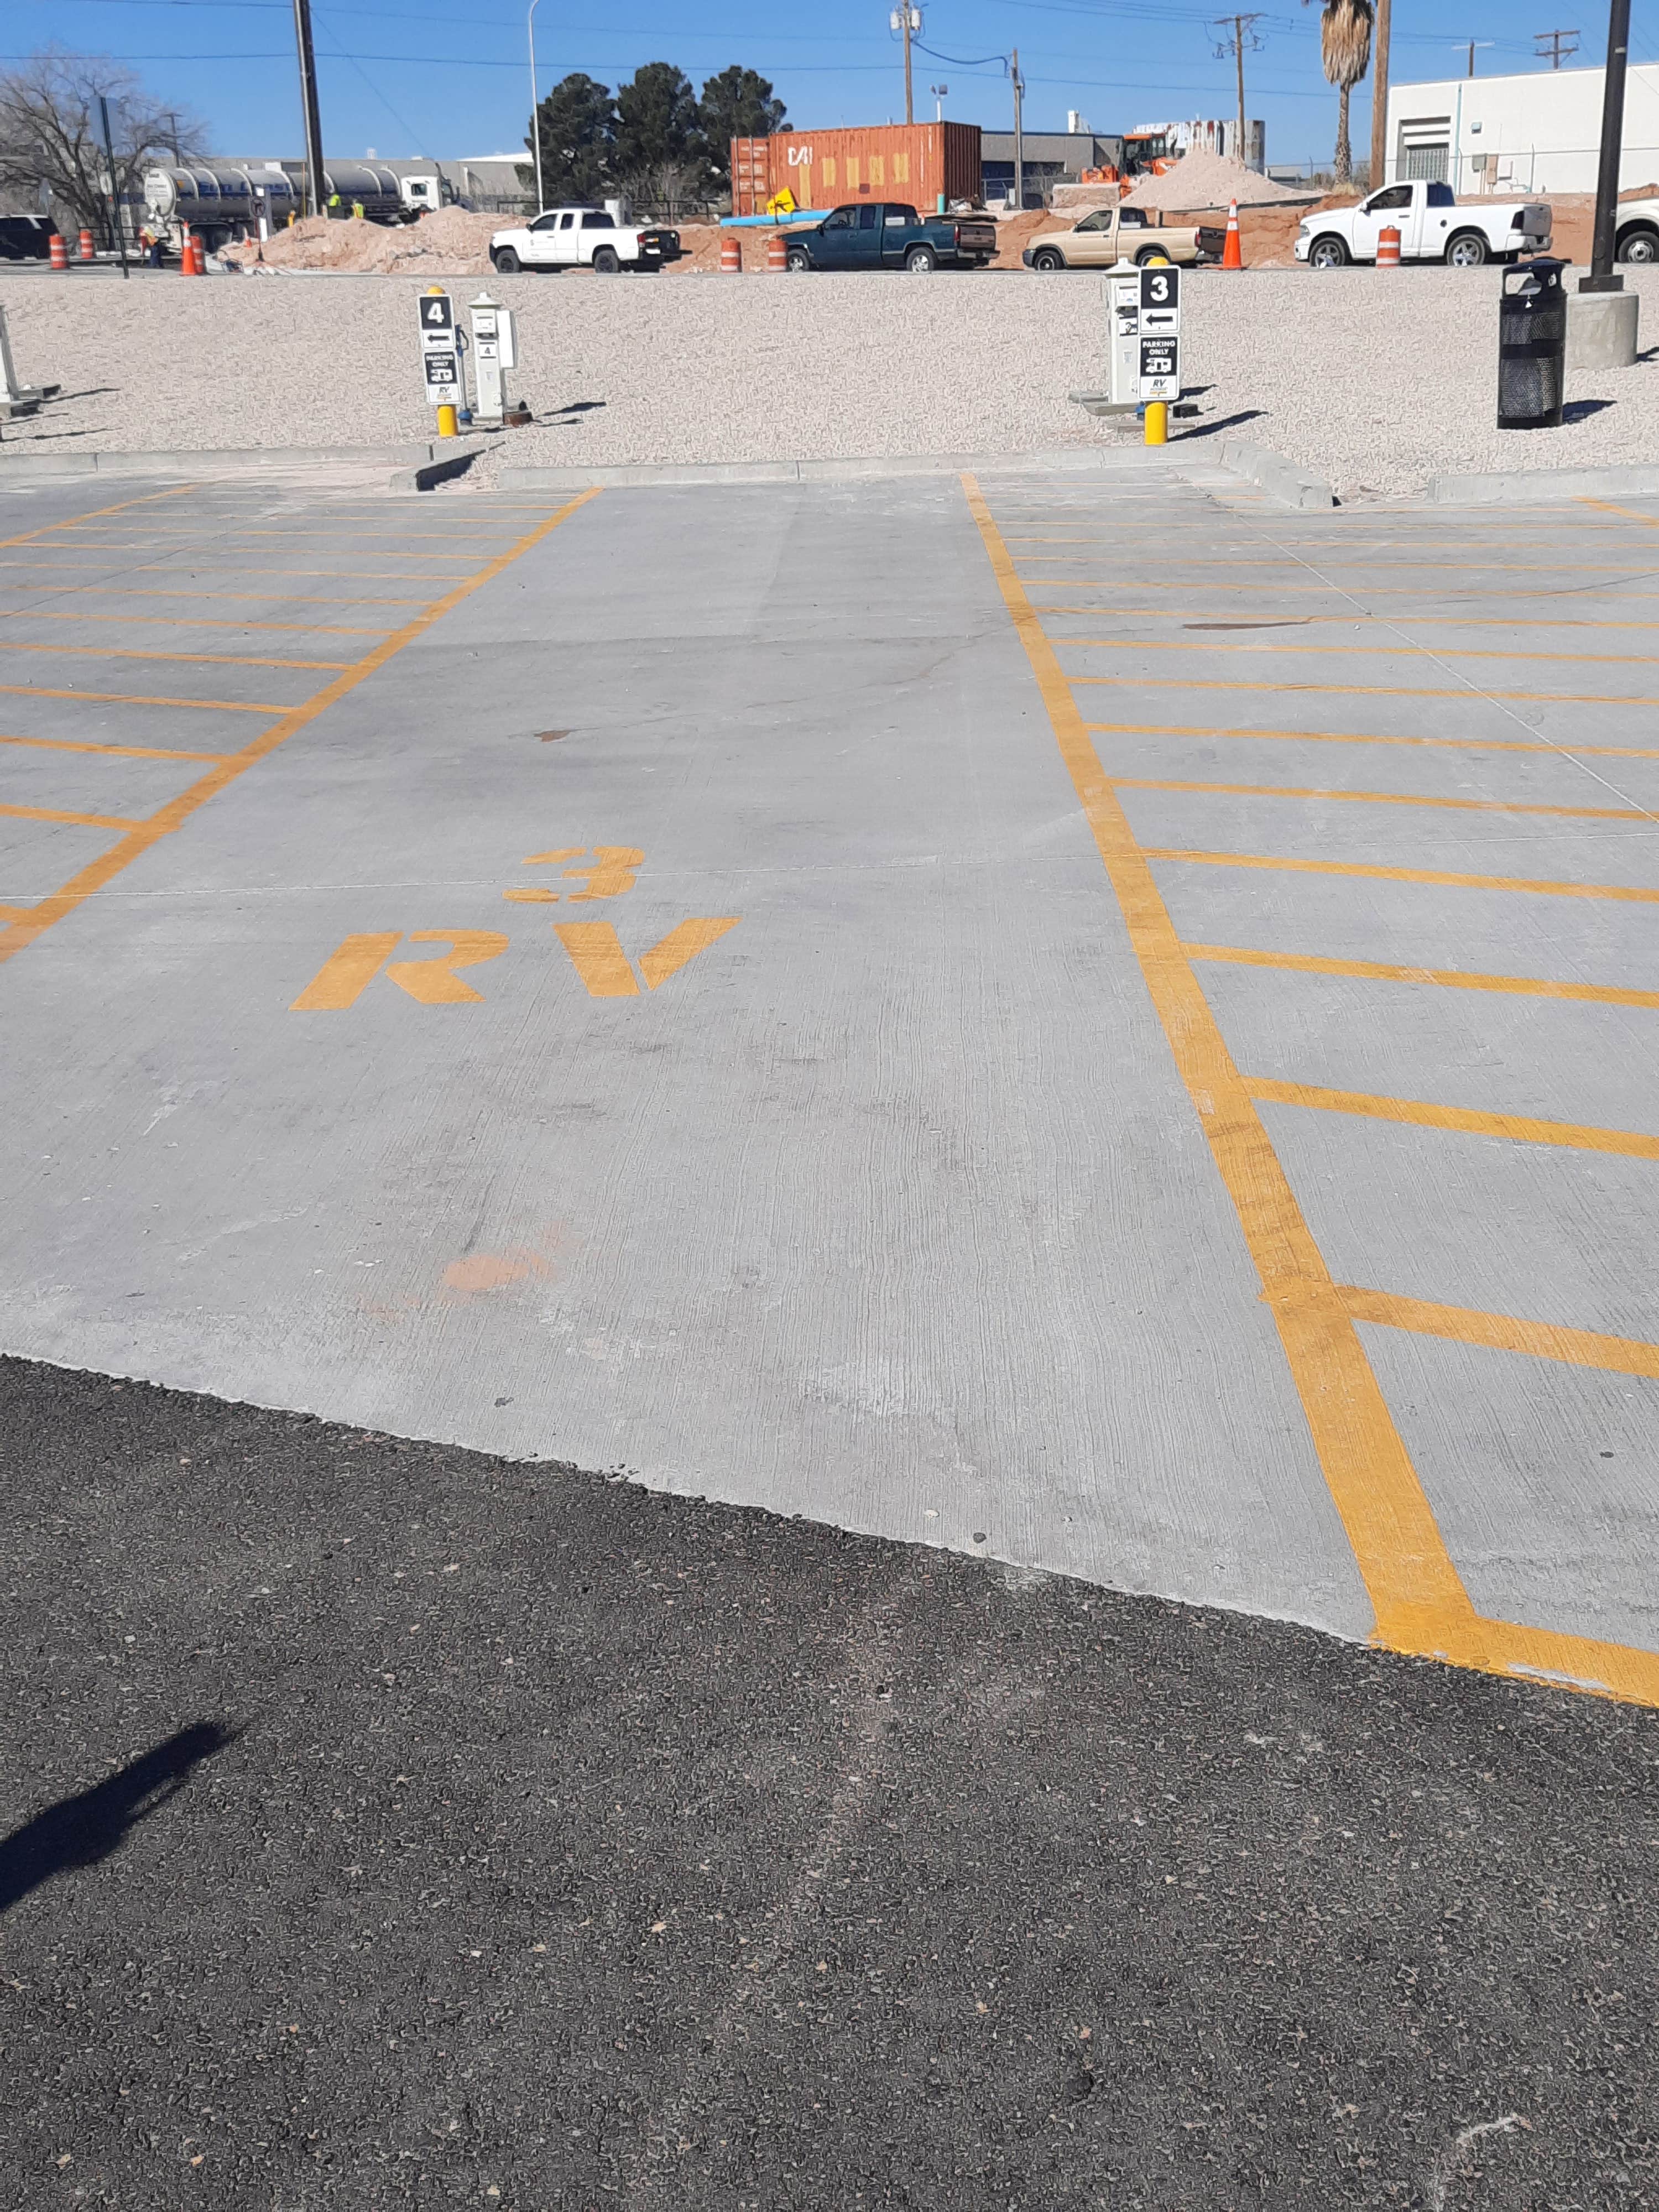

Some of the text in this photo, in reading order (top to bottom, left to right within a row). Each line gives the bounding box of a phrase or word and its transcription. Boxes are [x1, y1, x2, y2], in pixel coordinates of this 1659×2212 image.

[1150, 275, 1169, 301] 3
[427, 302, 445, 324] 4
[484, 347, 491, 355] 4
[1152, 379, 1167, 387] RV
[502, 844, 646, 904] 3
[289, 917, 744, 1011] RV
